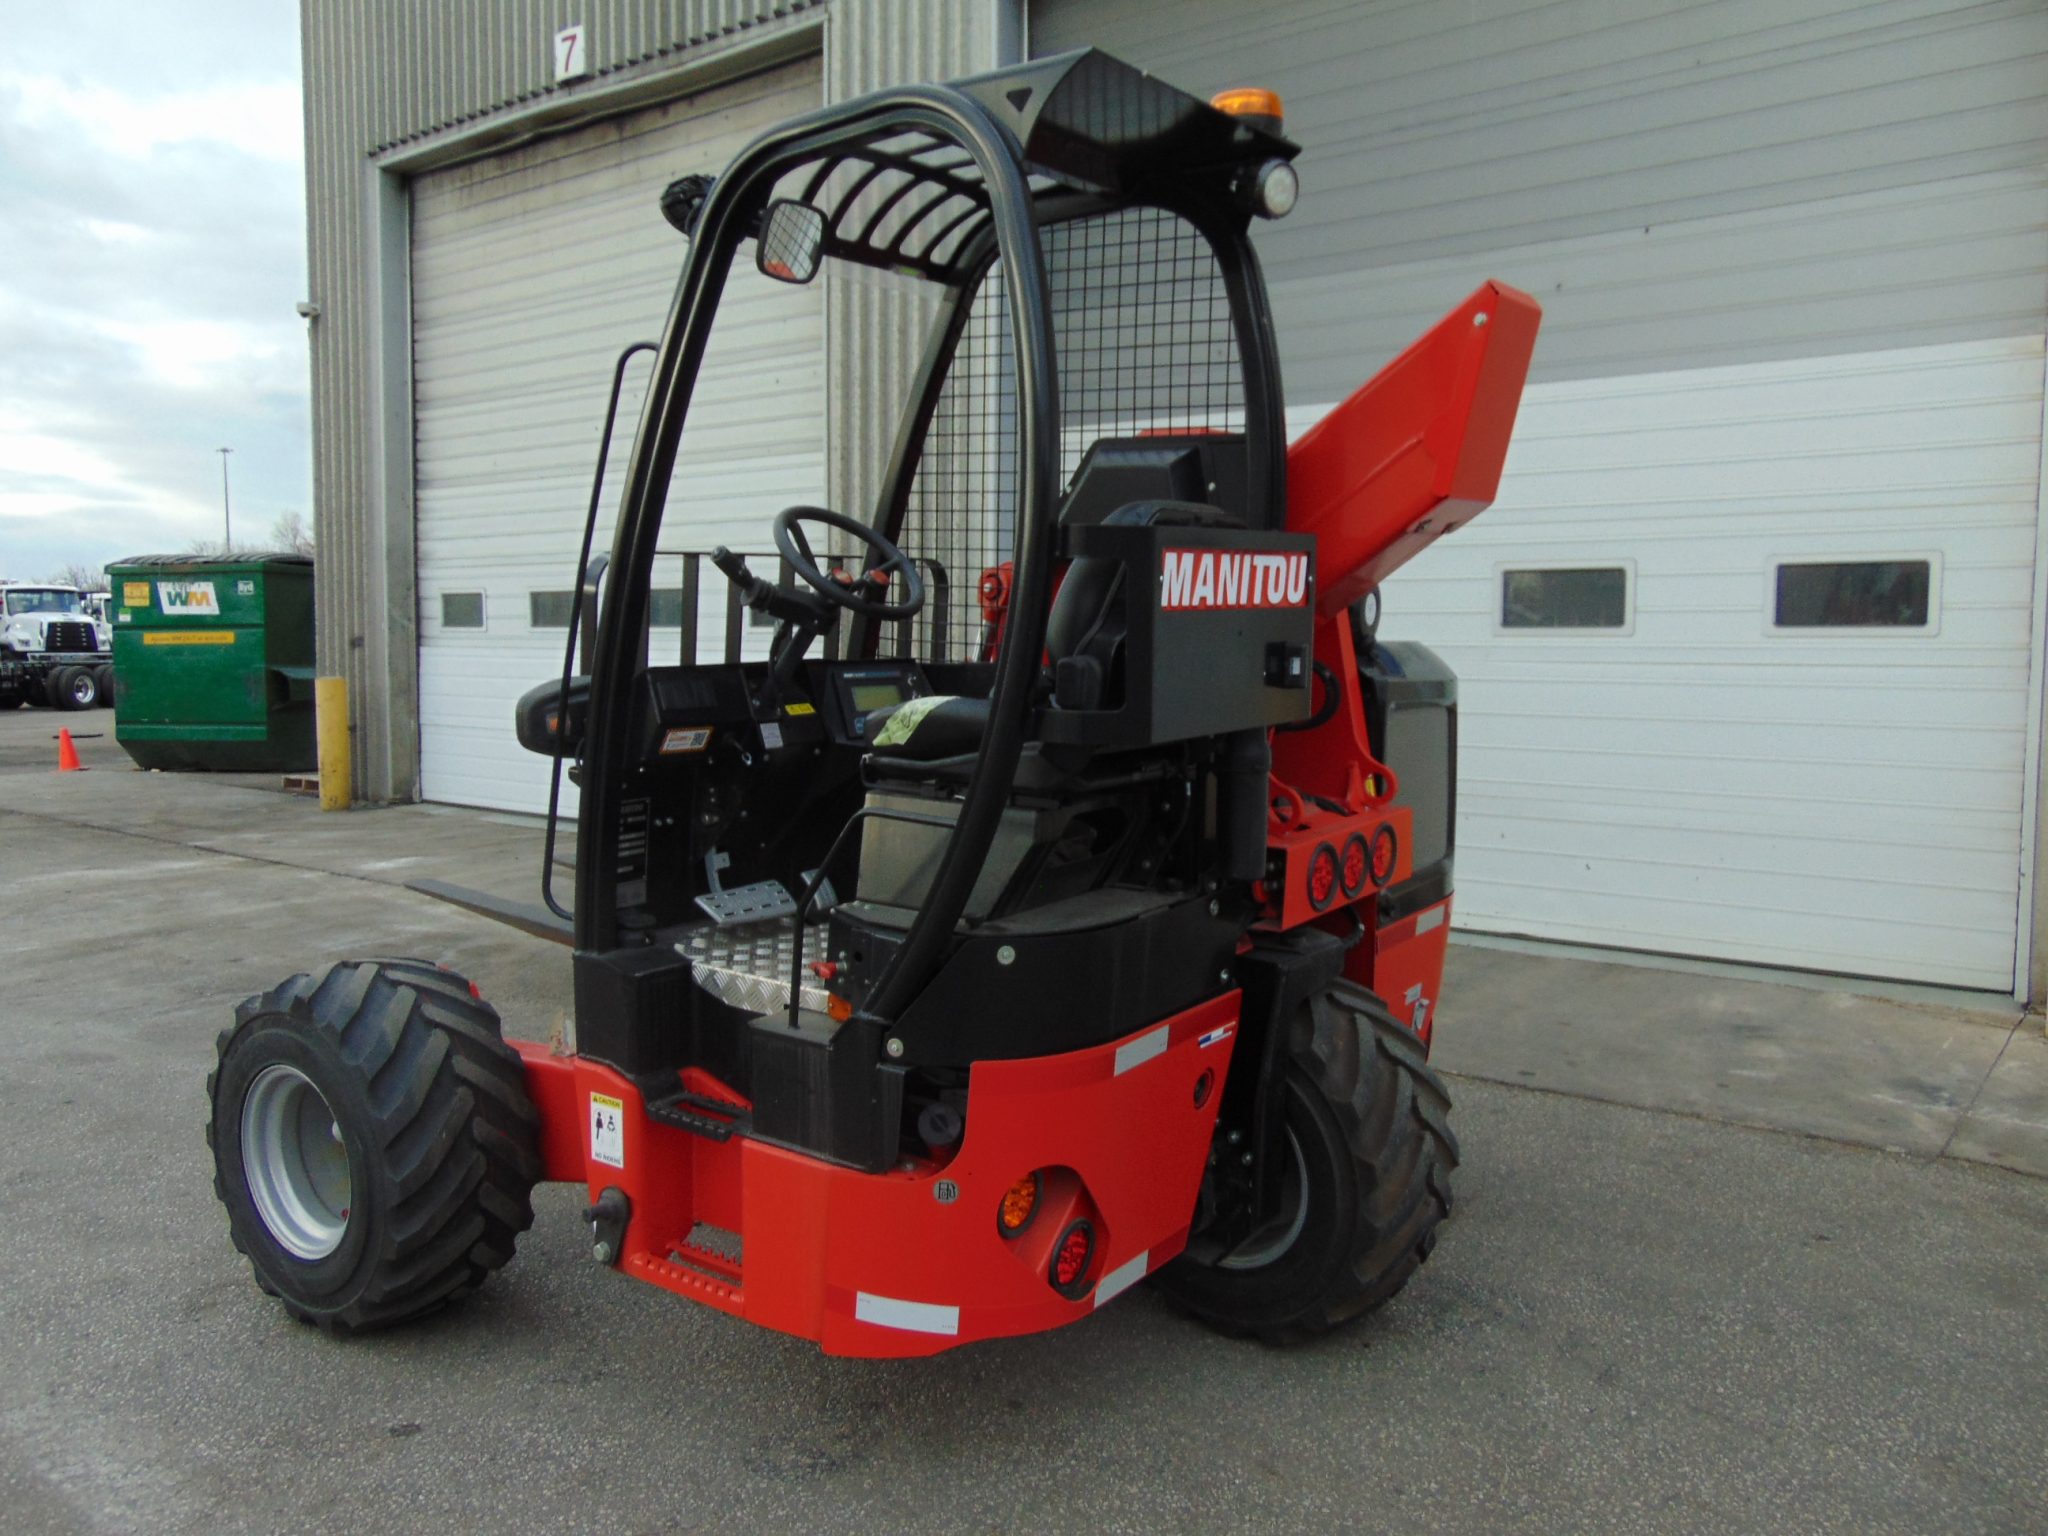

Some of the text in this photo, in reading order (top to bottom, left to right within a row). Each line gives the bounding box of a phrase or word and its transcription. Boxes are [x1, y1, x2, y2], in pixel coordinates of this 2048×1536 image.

[561, 34, 576, 72] 7
[166, 591, 211, 606] WM
[1161, 552, 1308, 607] MANITOU
